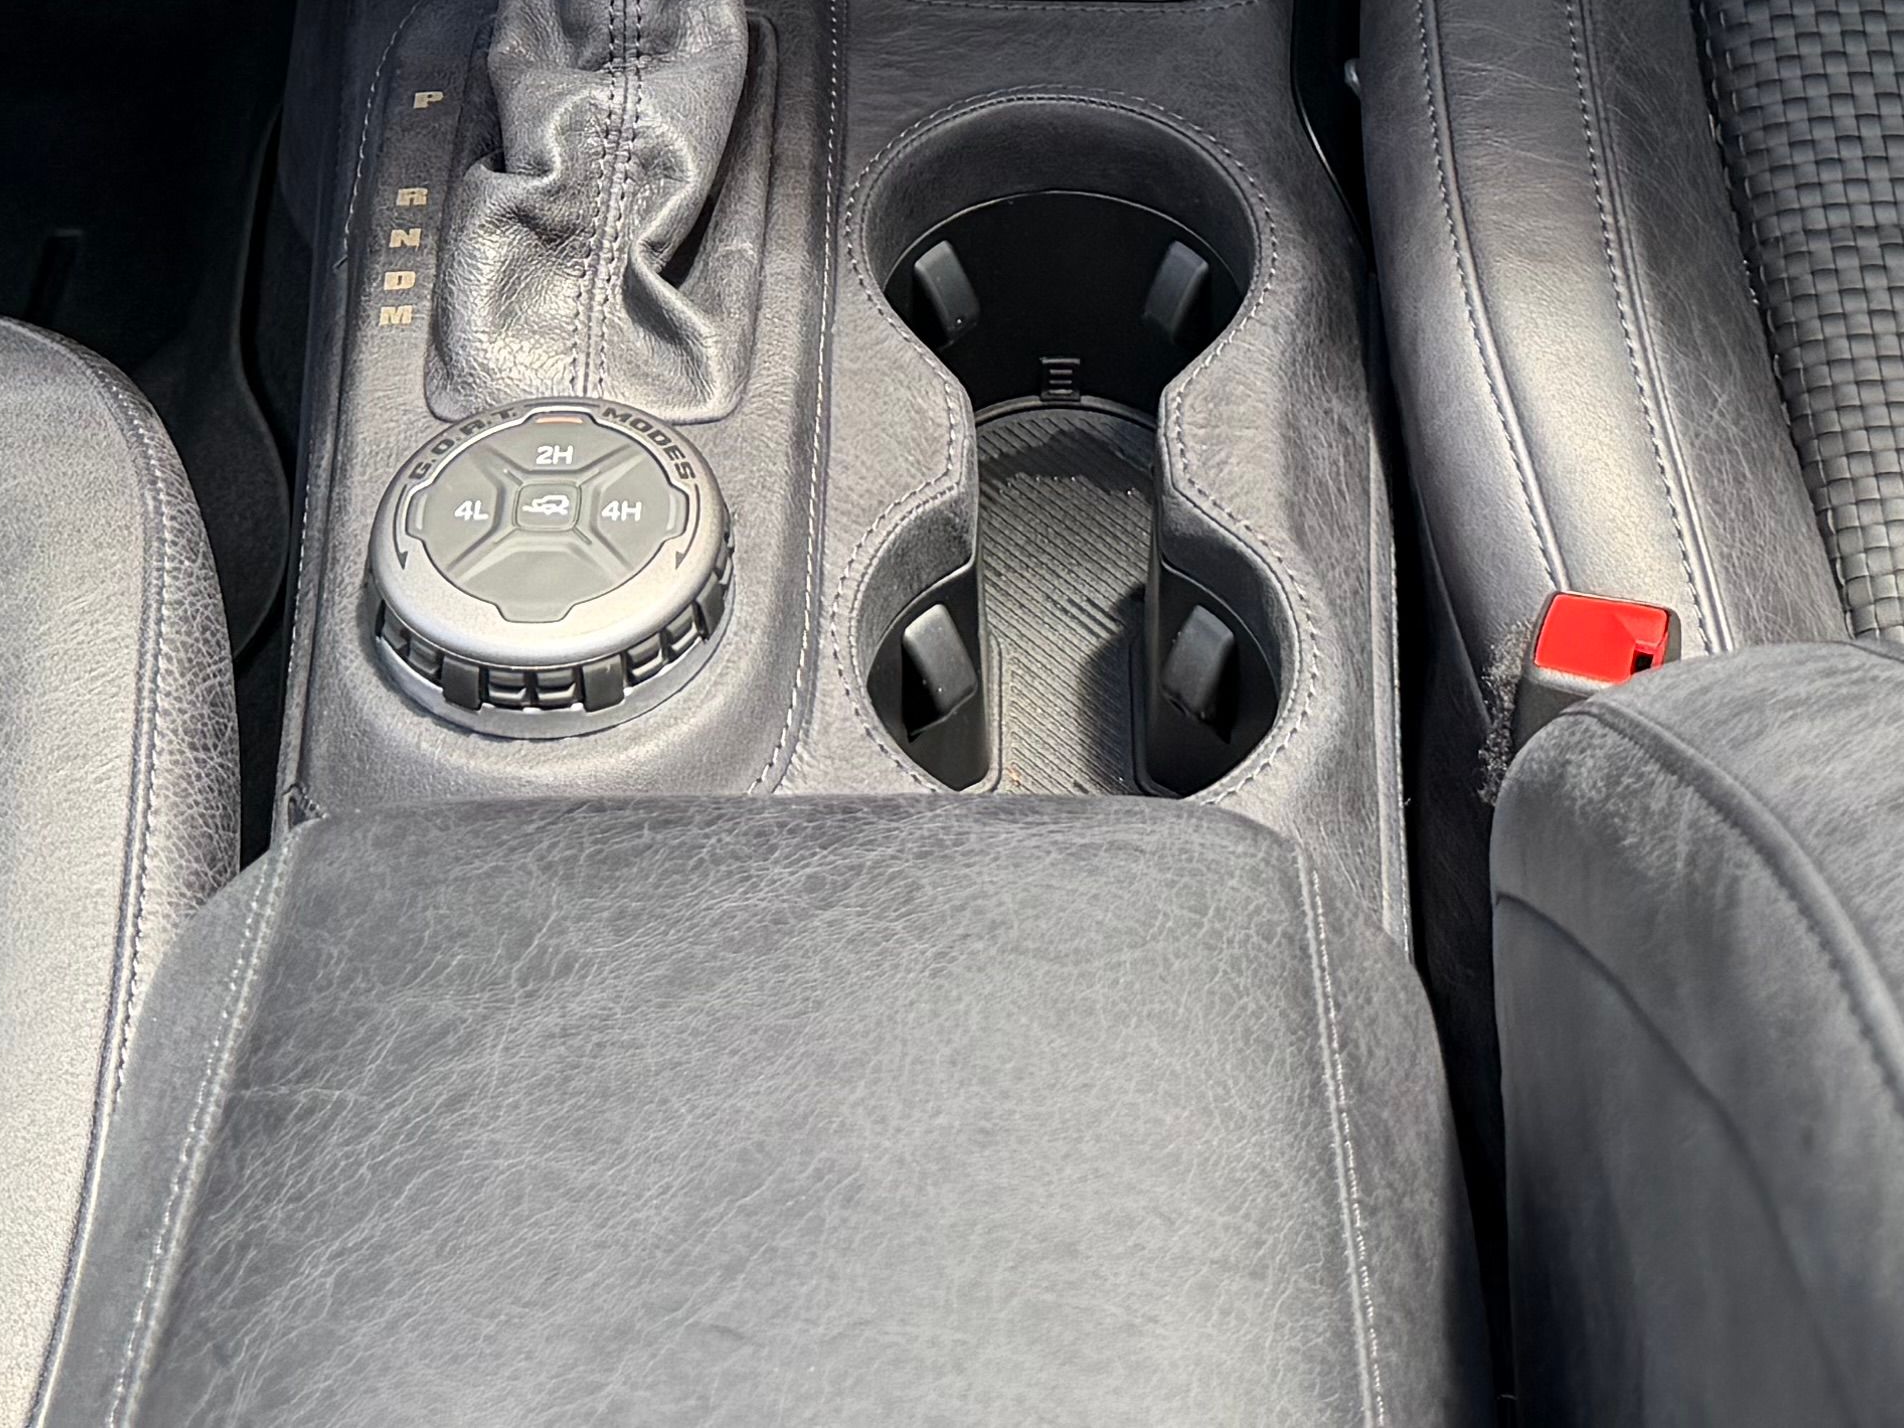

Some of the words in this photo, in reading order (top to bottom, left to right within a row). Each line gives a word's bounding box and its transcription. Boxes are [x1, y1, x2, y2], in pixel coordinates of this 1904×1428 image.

[413, 91, 444, 109] P
[396, 187, 428, 206] R
[389, 228, 421, 248] N
[383, 270, 416, 291] D
[379, 305, 413, 326] M
[535, 445, 574, 465] 2H
[602, 407, 696, 482] MODES
[454, 500, 489, 521] 4L
[601, 500, 642, 522] 4H
